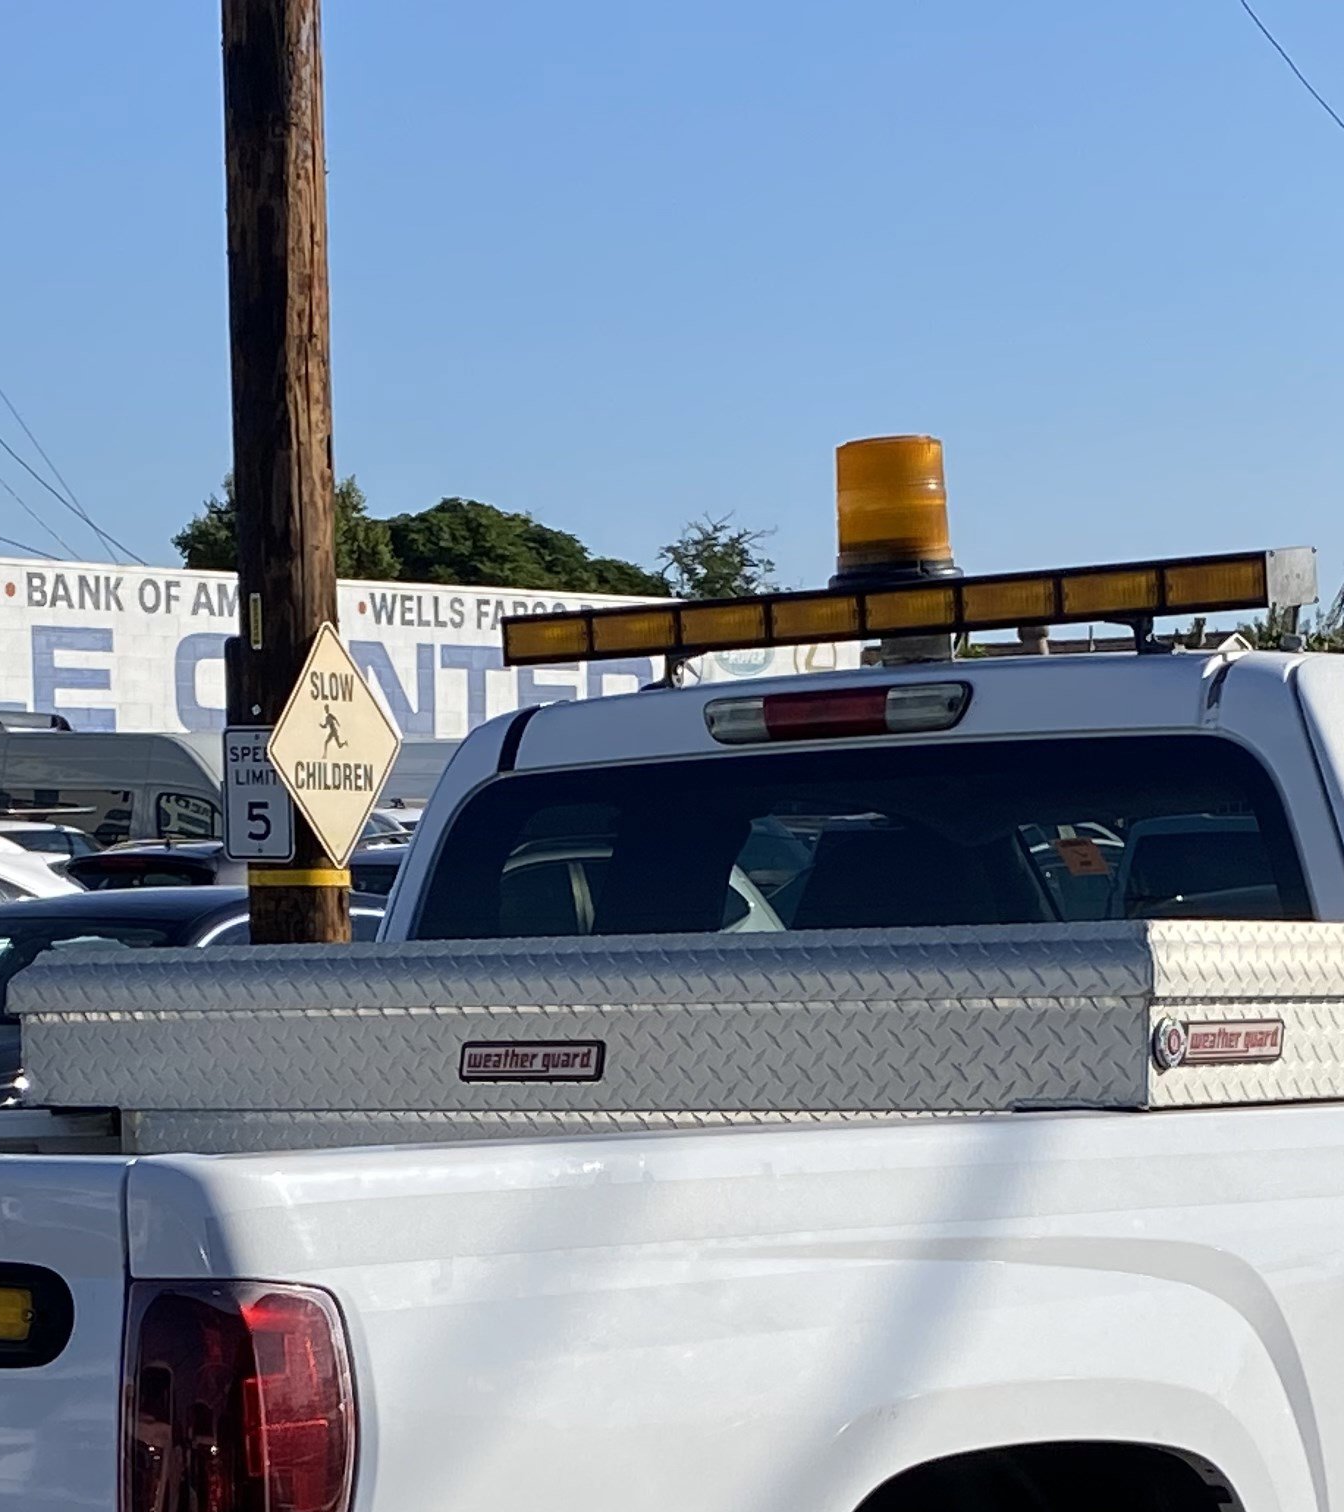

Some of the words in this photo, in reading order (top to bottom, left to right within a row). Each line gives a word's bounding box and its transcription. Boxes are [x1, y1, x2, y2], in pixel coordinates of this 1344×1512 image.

[26, 572, 124, 612] BANK
[138, 578, 181, 614] OF
[370, 593, 465, 629] WELLS
[310, 671, 354, 702] SLOW
[230, 746, 269, 762] SPEE
[235, 768, 278, 786] LIMIT
[294, 761, 374, 791] CHILDREN
[247, 801, 271, 841] 5
[1190, 1027, 1241, 1050] weather
[1244, 1026, 1279, 1053] guard
[467, 1048, 539, 1069] weather
[542, 1048, 592, 1073] guard
